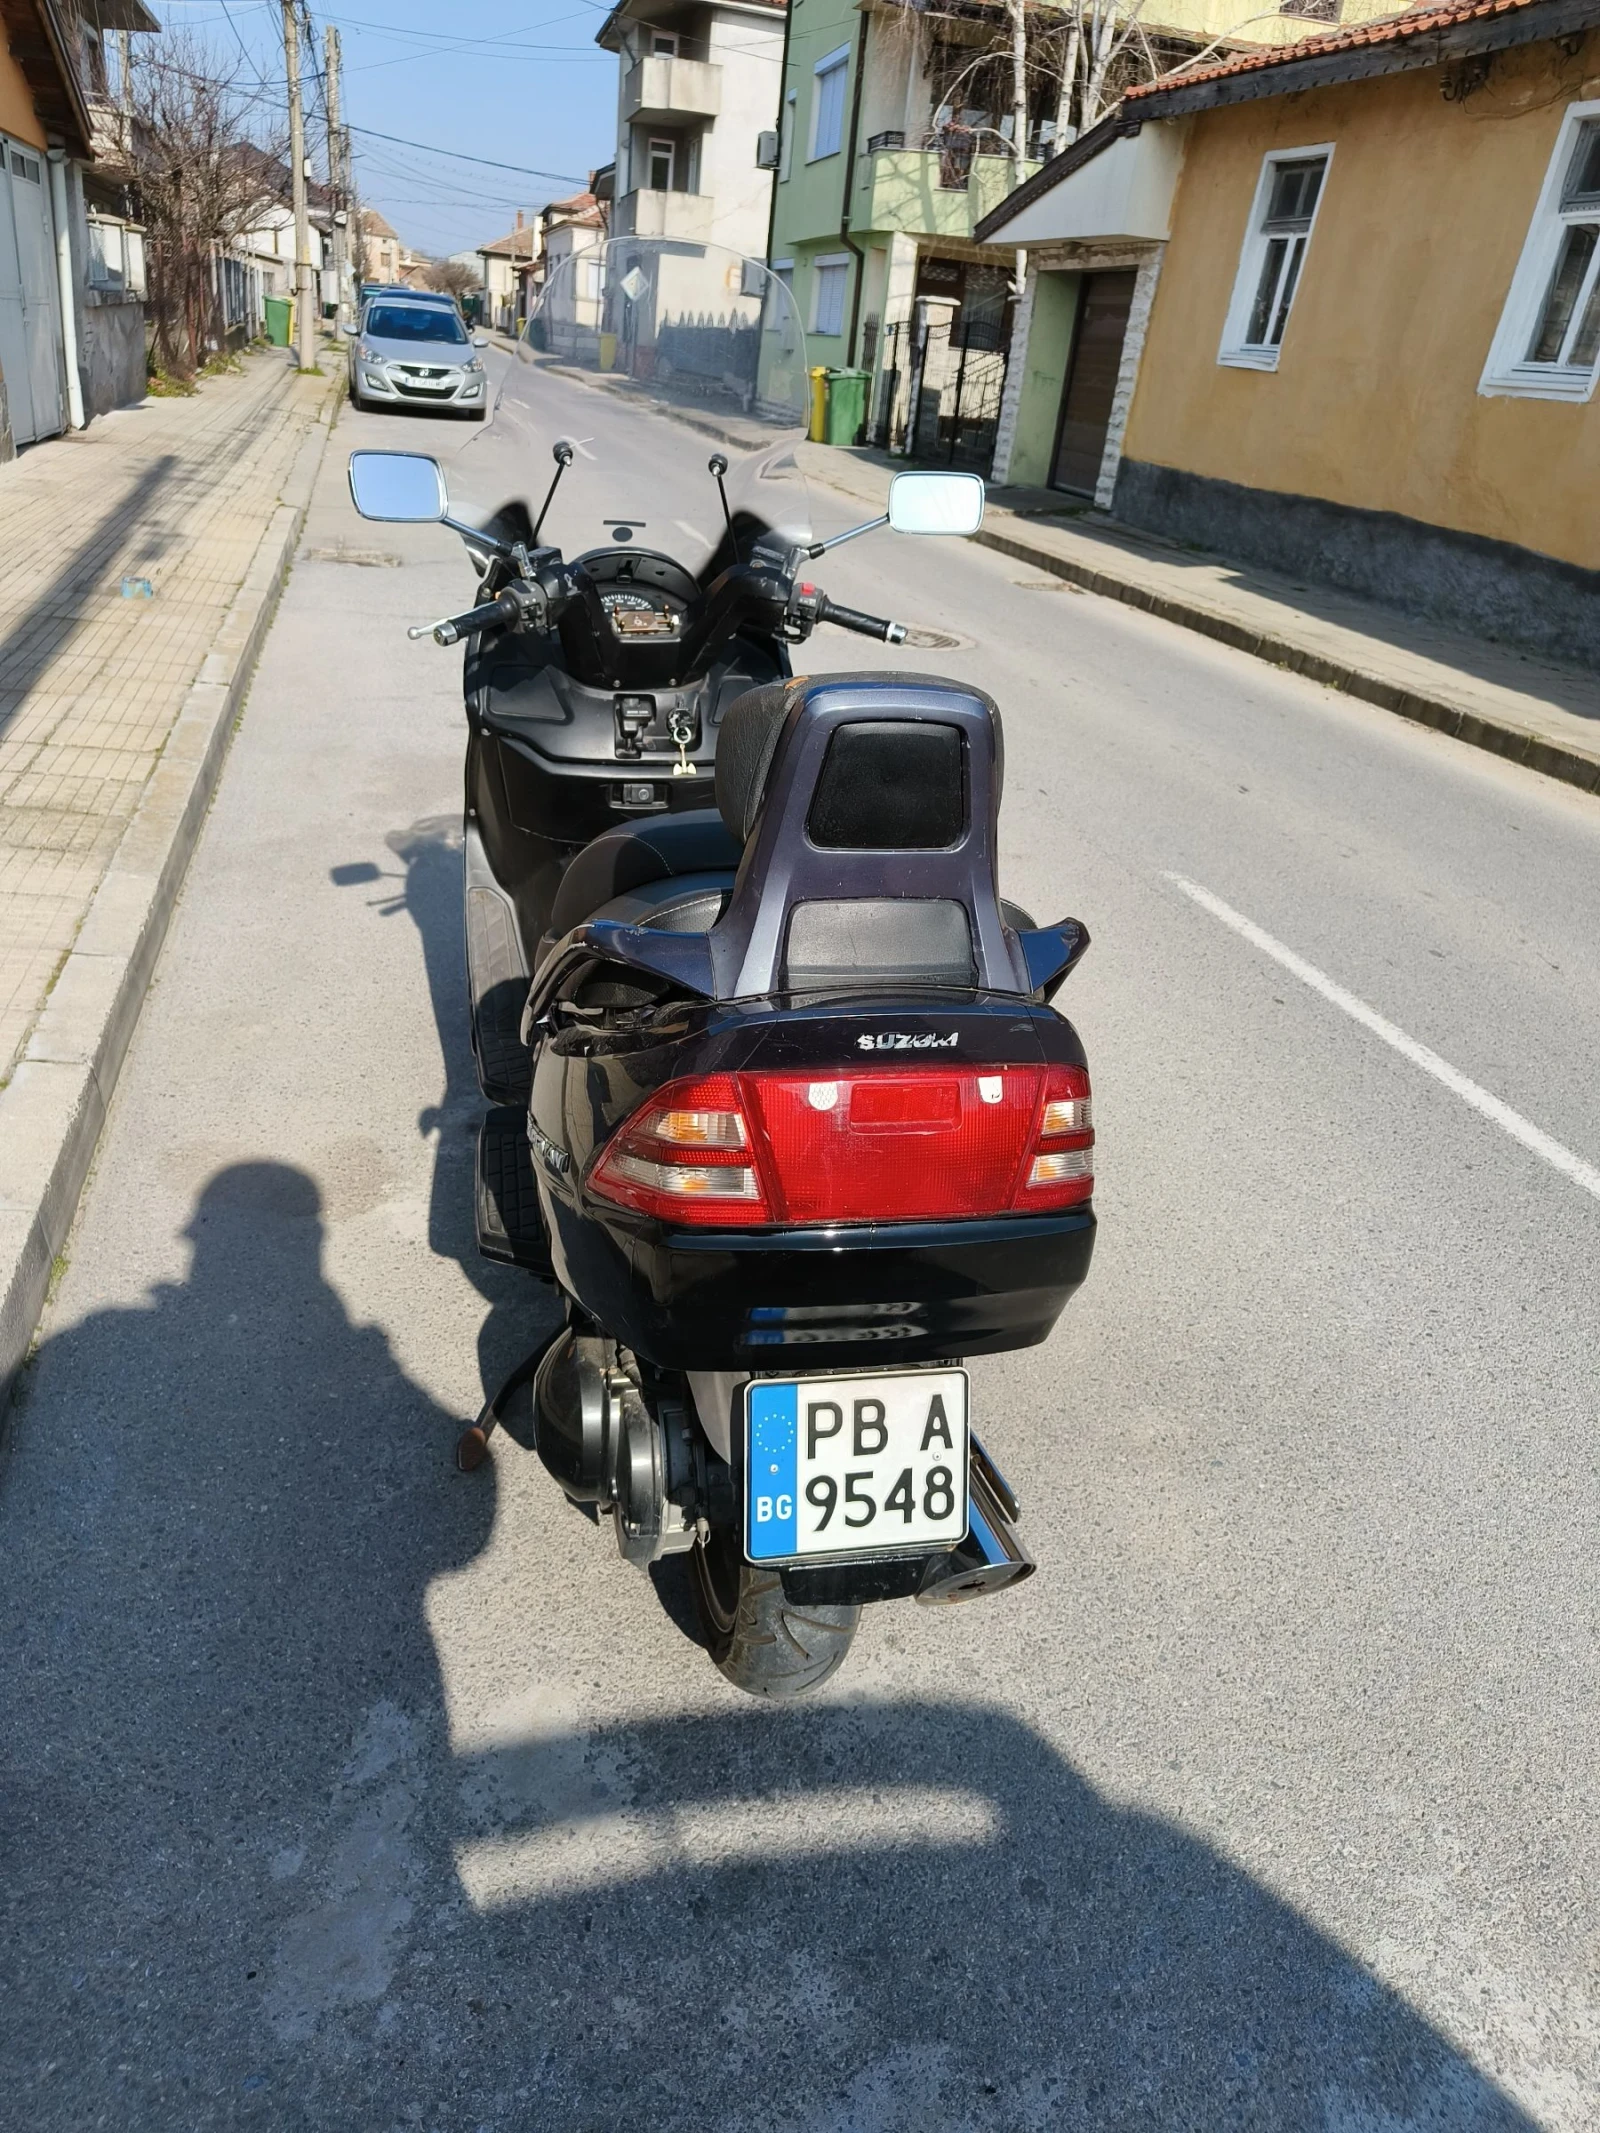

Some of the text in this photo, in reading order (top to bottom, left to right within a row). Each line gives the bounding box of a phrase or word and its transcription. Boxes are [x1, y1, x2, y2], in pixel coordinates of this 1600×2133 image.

[807, 1393, 954, 1460] PB A
[756, 1494, 793, 1523] BG
[805, 1465, 955, 1533] 9548
